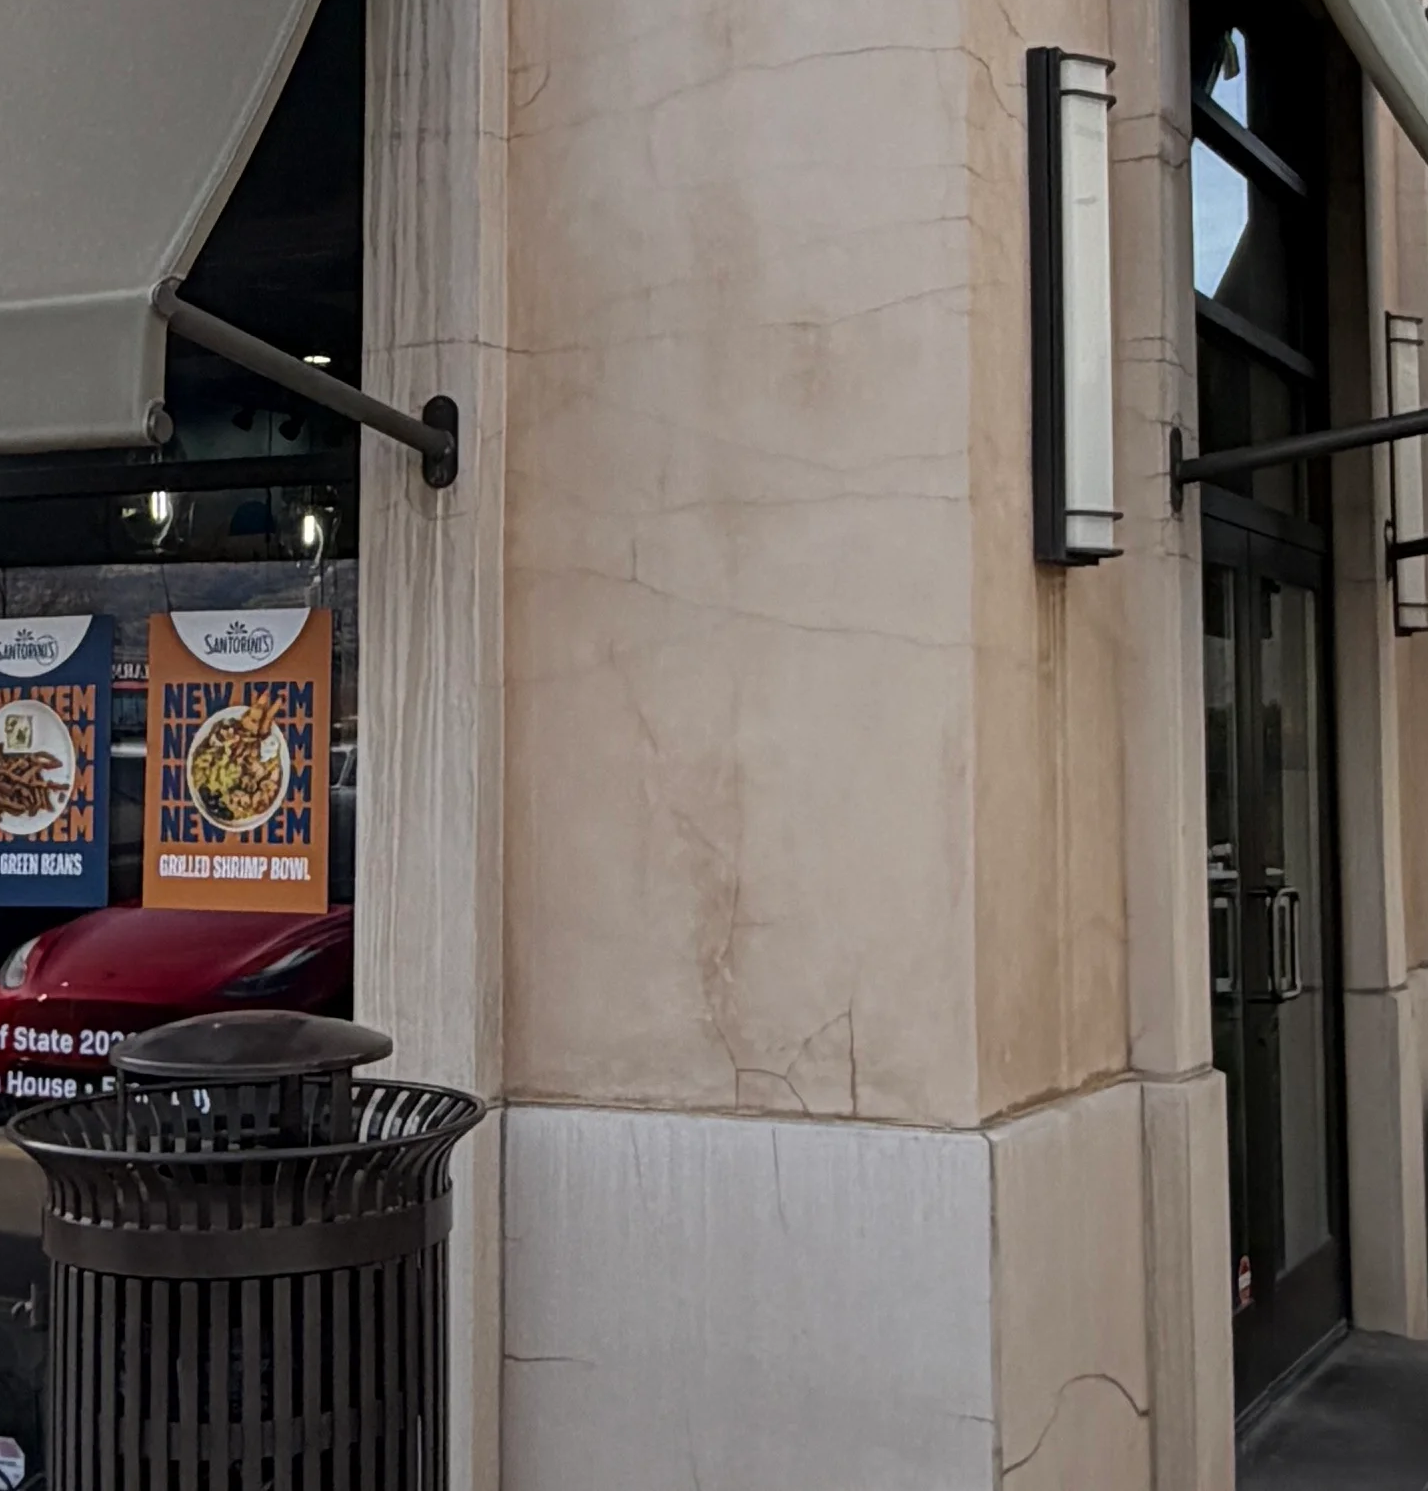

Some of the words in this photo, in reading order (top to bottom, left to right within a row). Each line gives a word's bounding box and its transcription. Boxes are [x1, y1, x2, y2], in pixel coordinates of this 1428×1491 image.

[163, 682, 233, 719] NEW
[0, 852, 39, 877] GREEN
[41, 852, 83, 877] BEANS
[160, 853, 210, 878] GRILLED
[212, 854, 268, 880] SHRIMP
[270, 856, 311, 881] BOWL
[13, 1026, 73, 1054] State
[79, 1028, 137, 1056] 202
[7, 1069, 78, 1099] House
